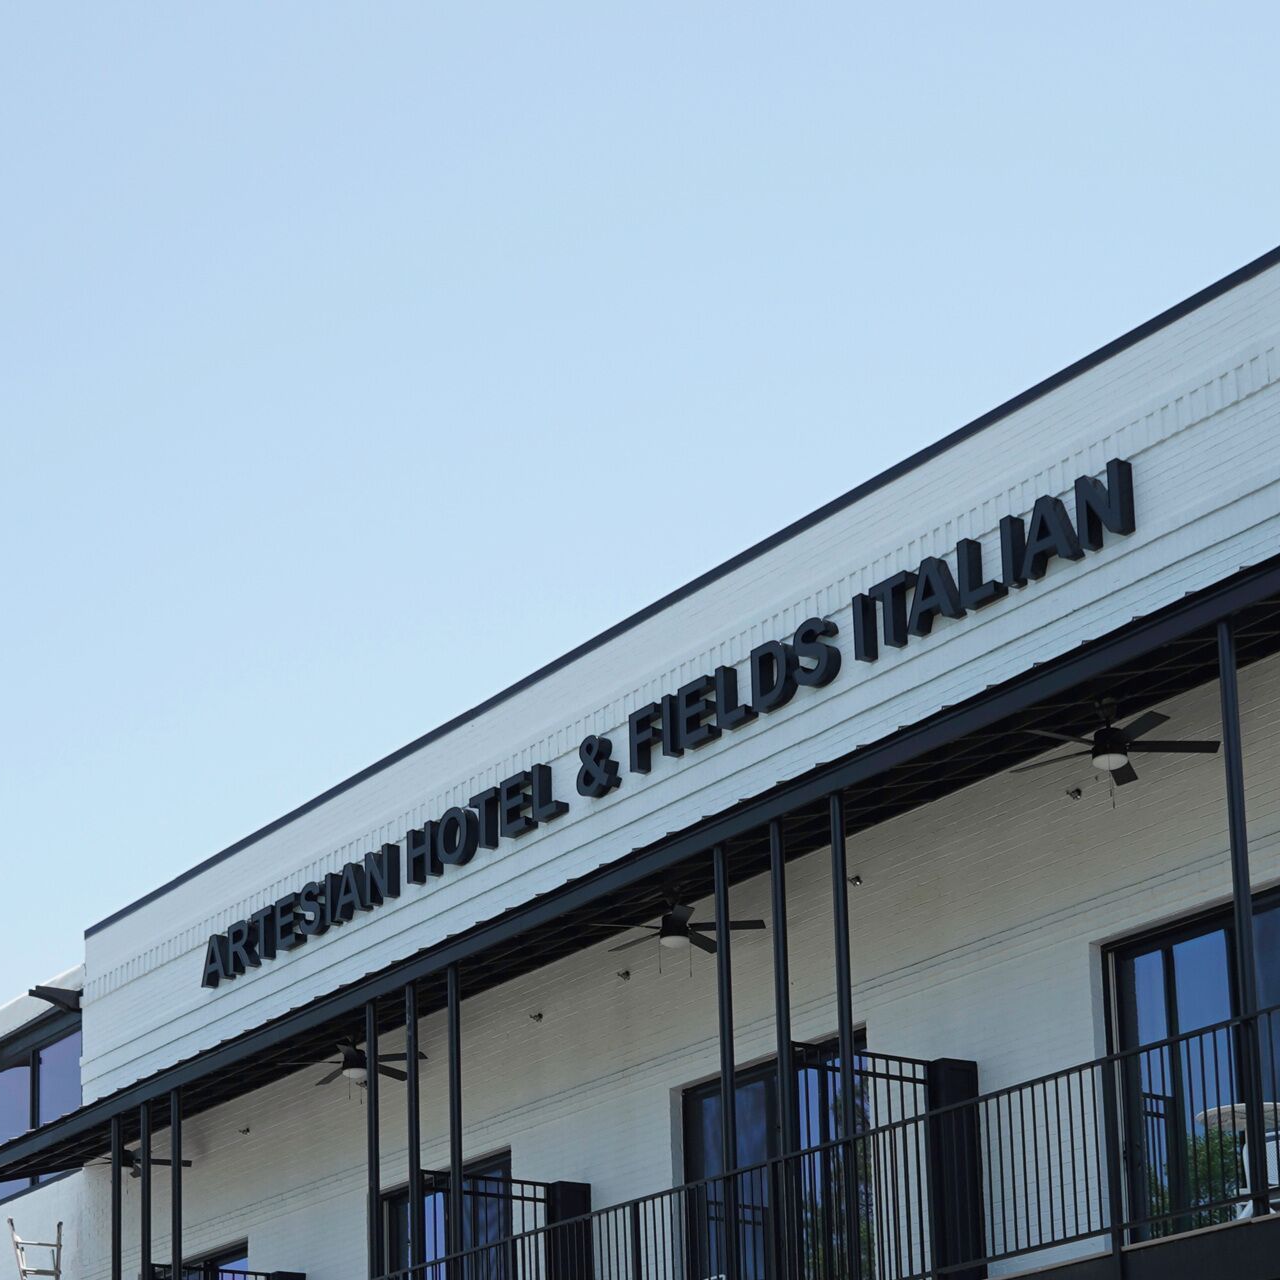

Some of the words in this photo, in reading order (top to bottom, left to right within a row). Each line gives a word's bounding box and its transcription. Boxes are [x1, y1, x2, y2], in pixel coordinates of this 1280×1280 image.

[200, 843, 401, 989] ARTESIAN
[406, 763, 570, 886] HOTEL
[575, 734, 623, 800] &
[628, 617, 842, 775] FIELDS
[852, 458, 1137, 664] ITALIAN
